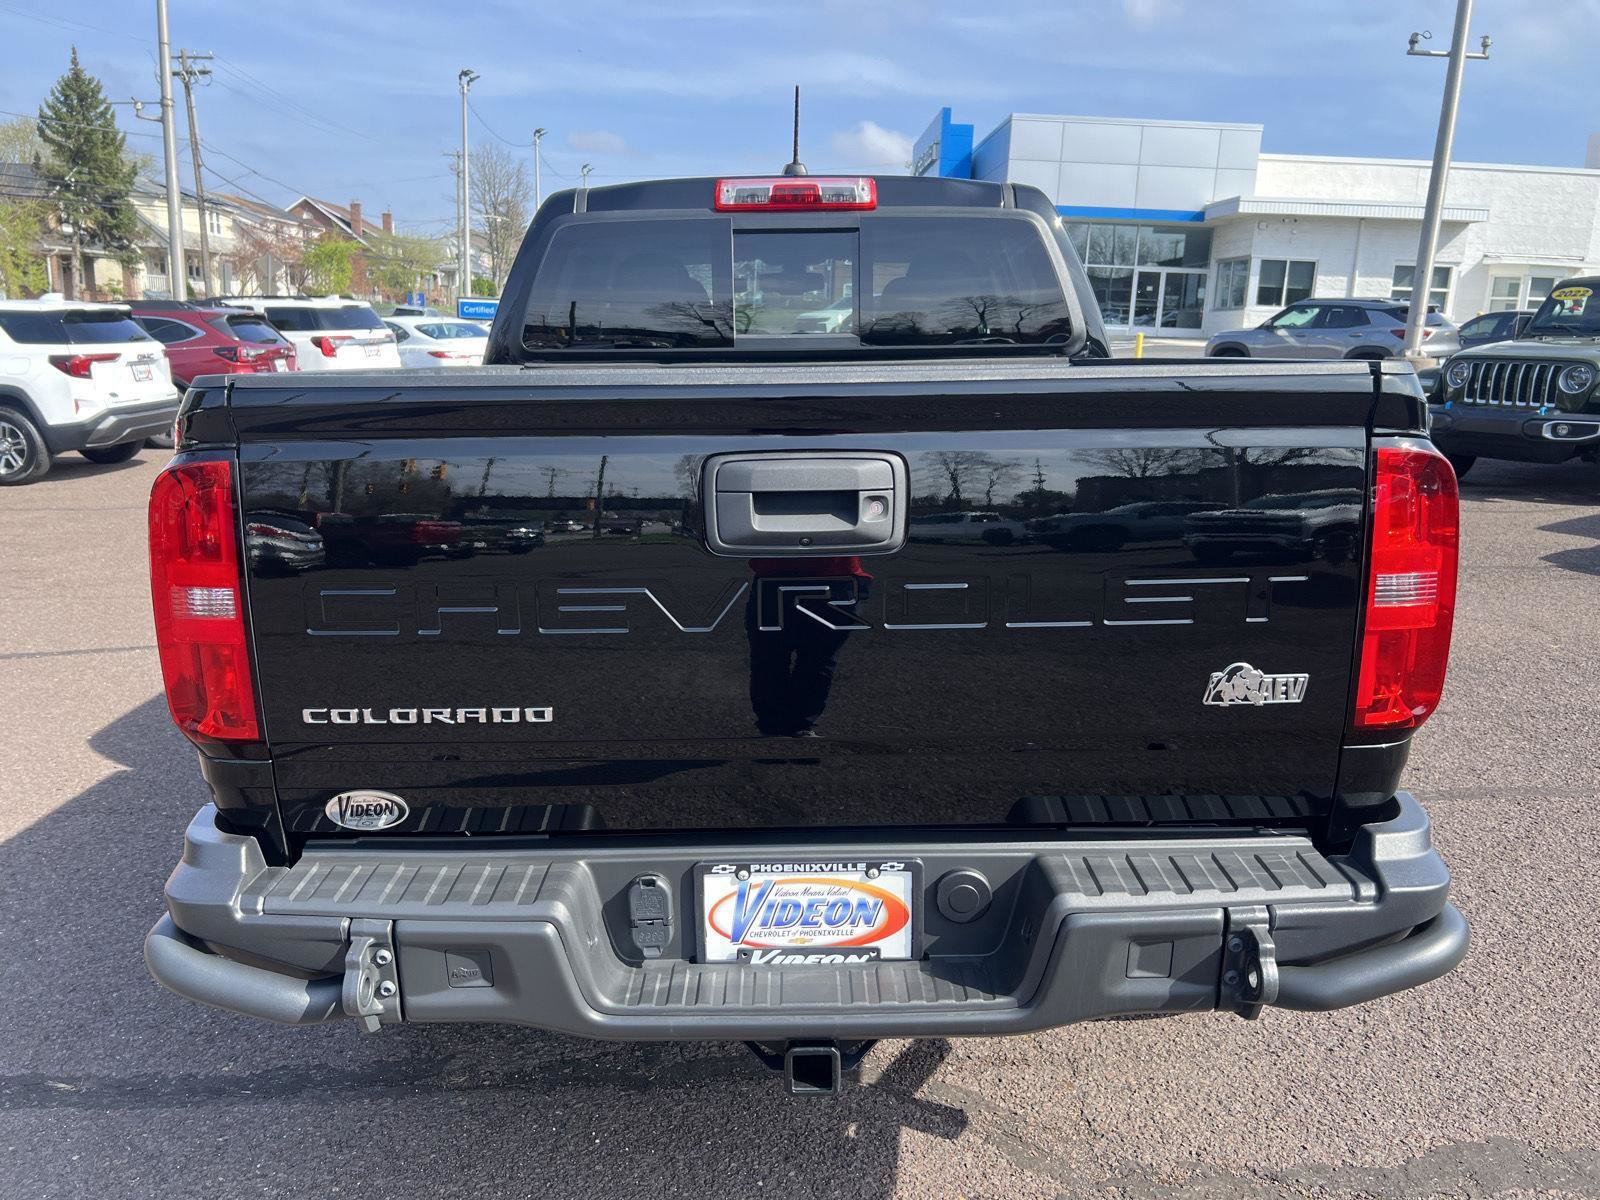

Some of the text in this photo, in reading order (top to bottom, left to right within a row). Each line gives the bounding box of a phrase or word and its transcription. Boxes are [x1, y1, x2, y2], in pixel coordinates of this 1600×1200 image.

[463, 305, 495, 314] Certified
[303, 574, 1309, 636] CHEVROLET
[1260, 678, 1305, 701] AEV
[302, 706, 554, 725] COLORADO
[338, 796, 395, 825] VIDEON
[750, 862, 867, 873] PHOENIXVILLE
[730, 879, 884, 945] VIDEON
[749, 930, 790, 938] CHEVROLET
